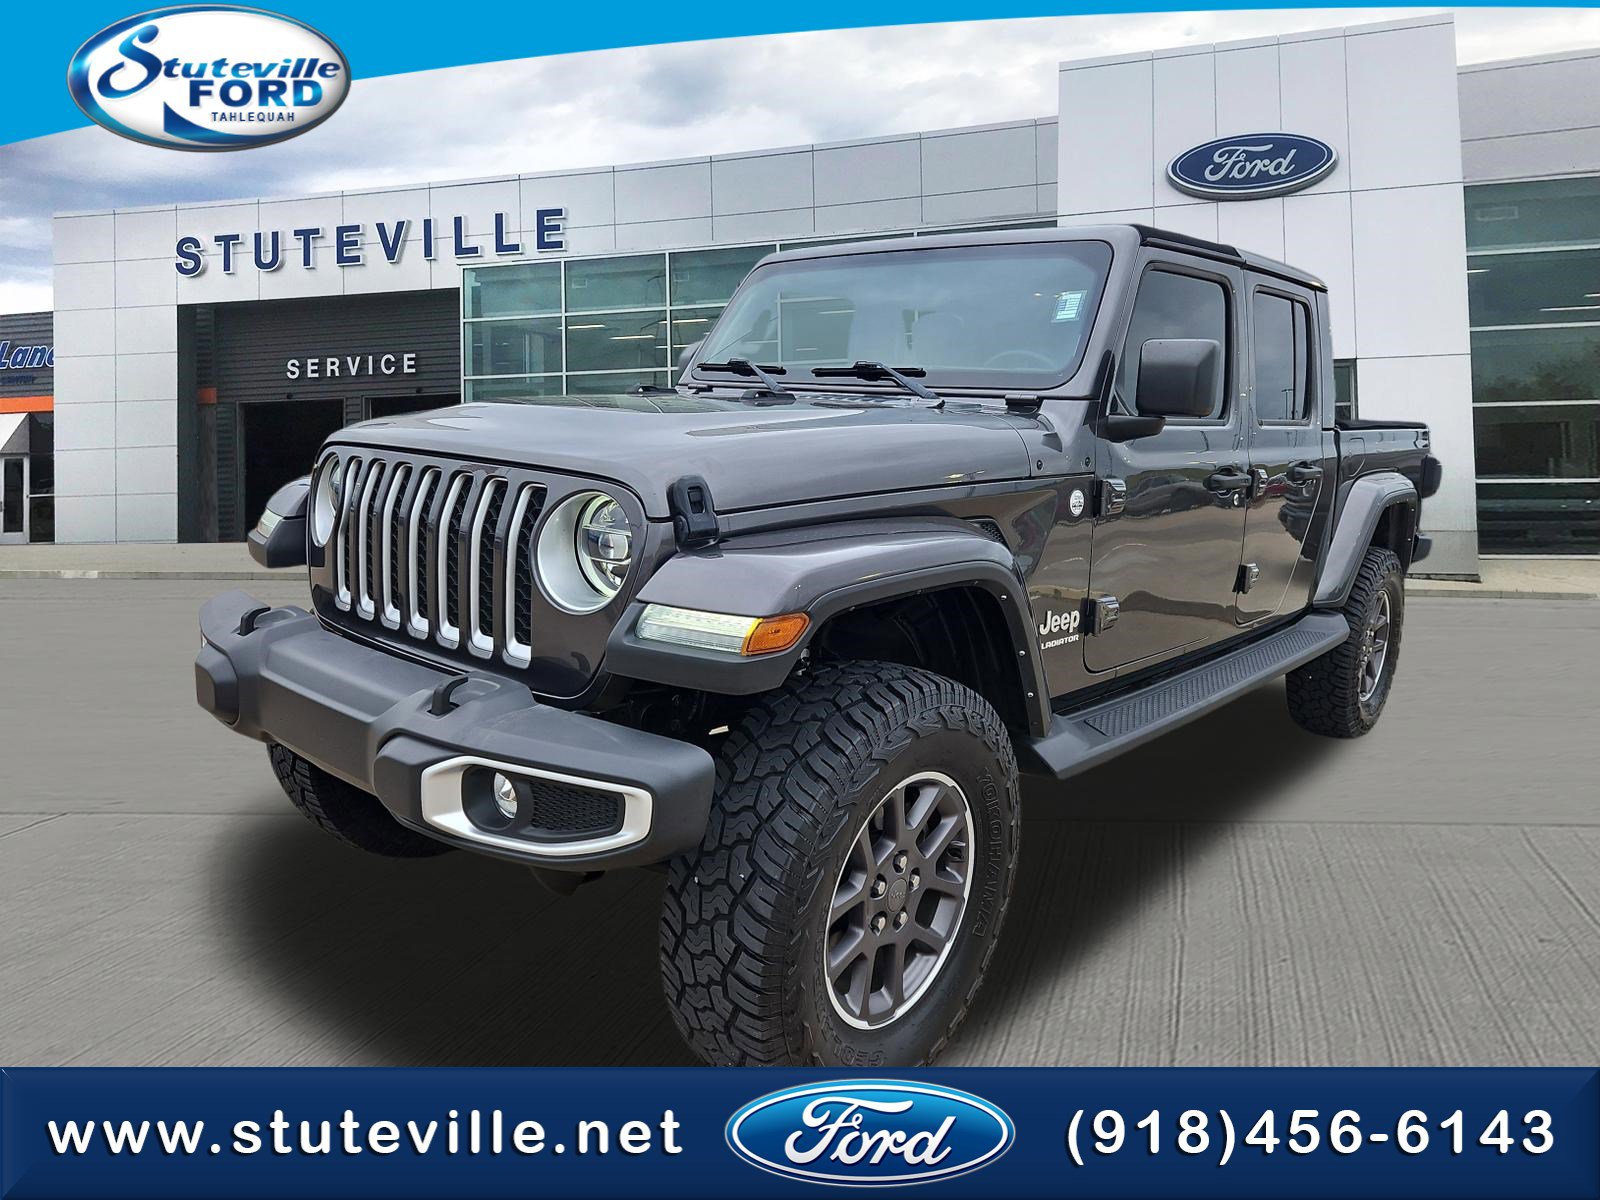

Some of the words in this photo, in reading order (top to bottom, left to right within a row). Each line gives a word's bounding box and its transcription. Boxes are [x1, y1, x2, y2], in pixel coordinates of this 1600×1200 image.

[1204, 143, 1297, 181] Ford
[175, 208, 567, 277] STUTEVILLE
[286, 353, 417, 380] SERVICE
[1040, 610, 1080, 635] Jeep
[1041, 634, 1079, 650] LADIATOR
